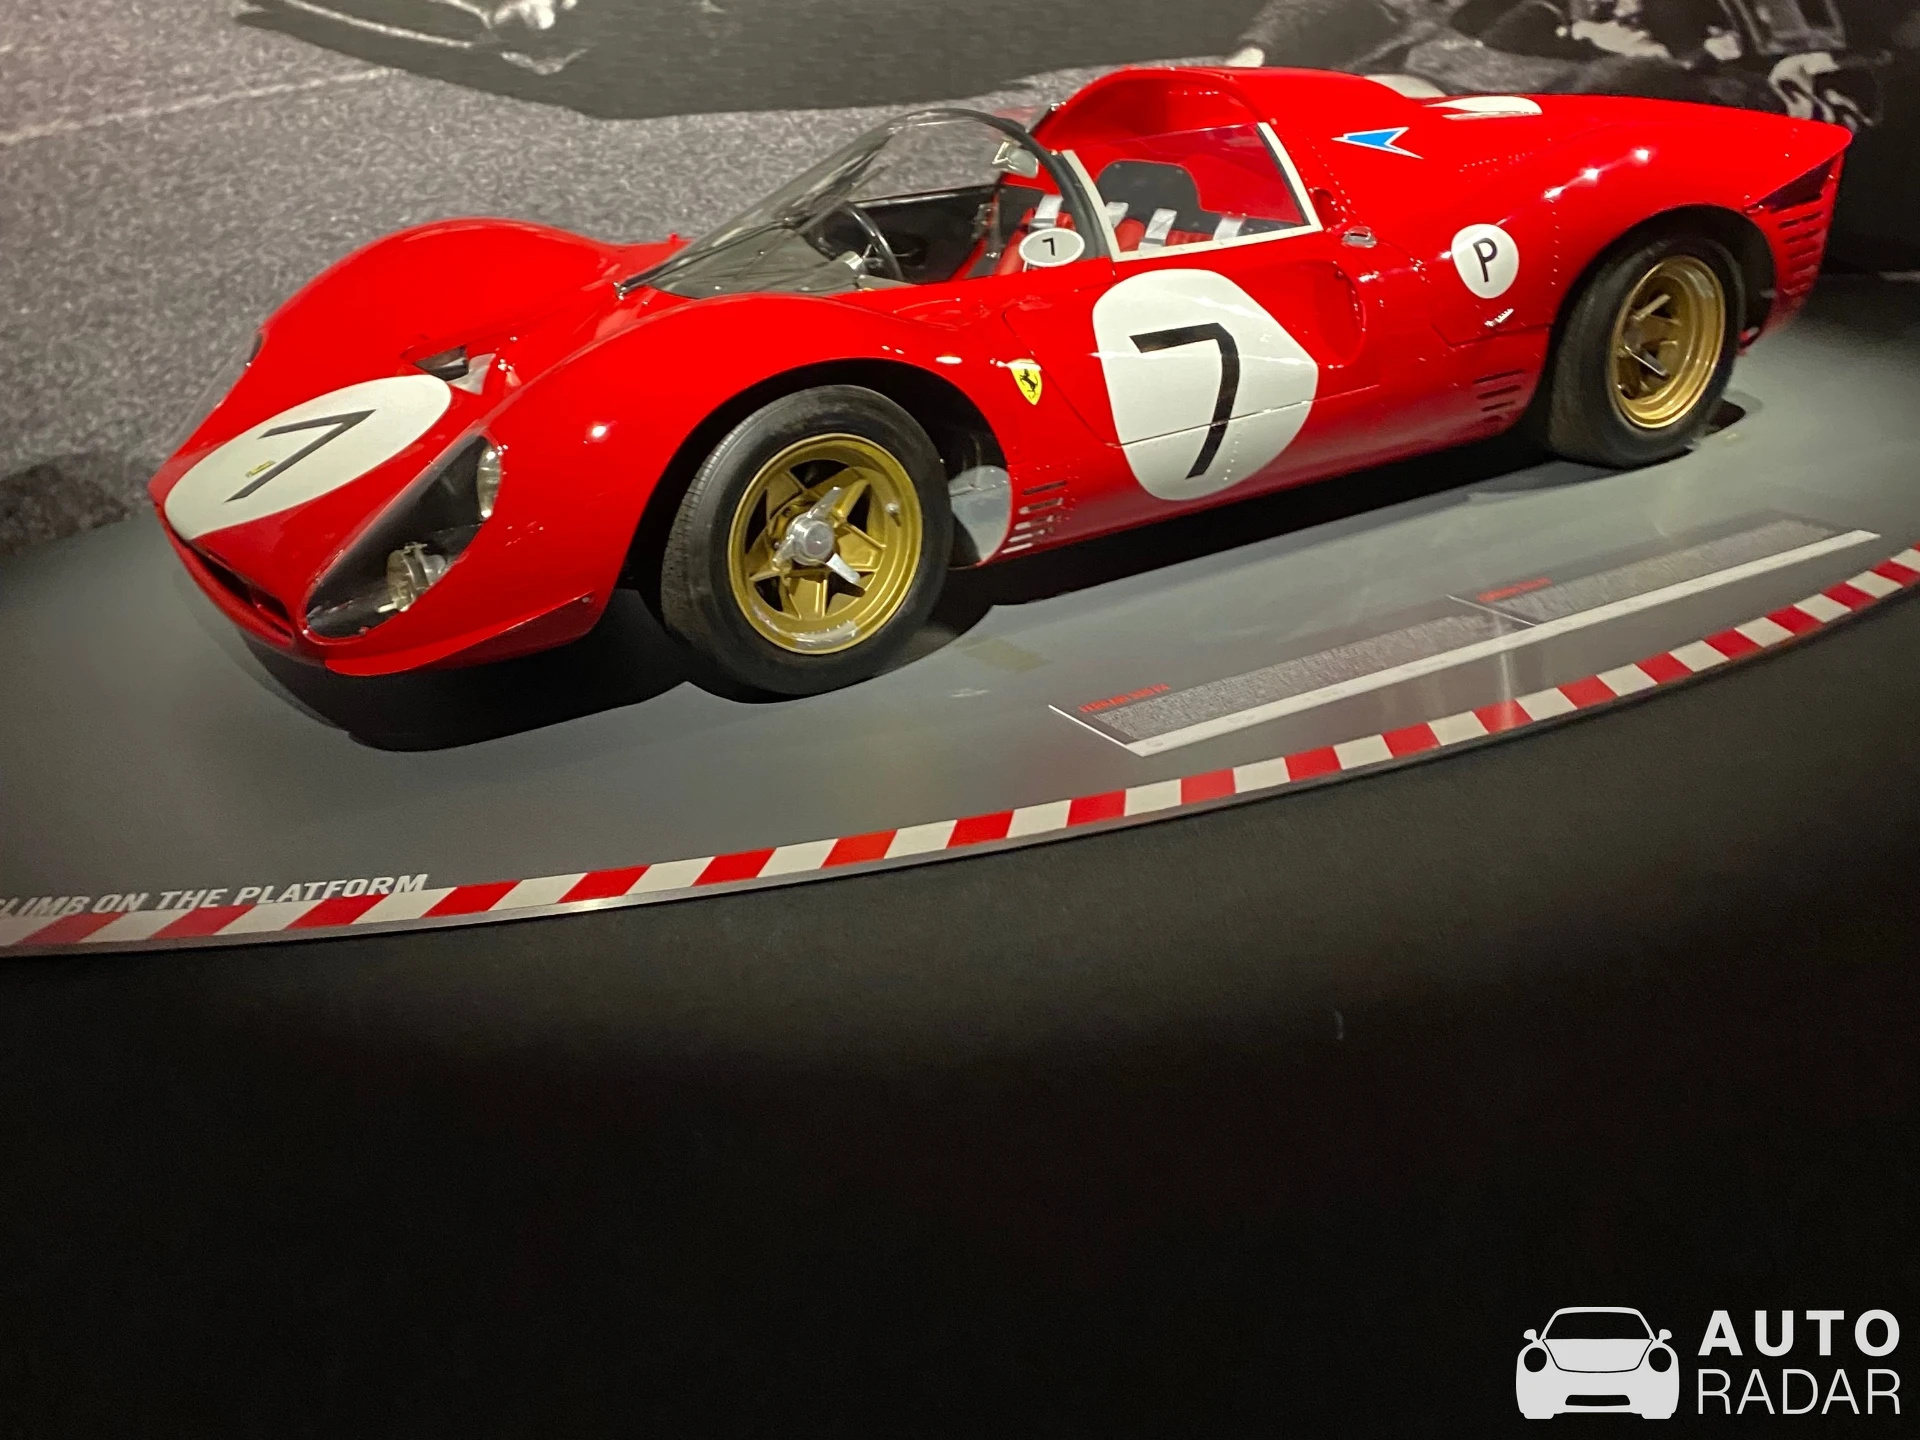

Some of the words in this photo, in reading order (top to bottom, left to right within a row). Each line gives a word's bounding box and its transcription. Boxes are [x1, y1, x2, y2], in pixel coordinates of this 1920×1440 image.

[1042, 237, 1056, 256] 7
[1473, 237, 1498, 283] P
[1129, 322, 1241, 480] 7
[225, 409, 377, 503] 7
[0, 896, 91, 917] LIMB
[92, 892, 149, 914] ON
[155, 888, 228, 910] THE
[233, 873, 428, 906] PLATFORM
